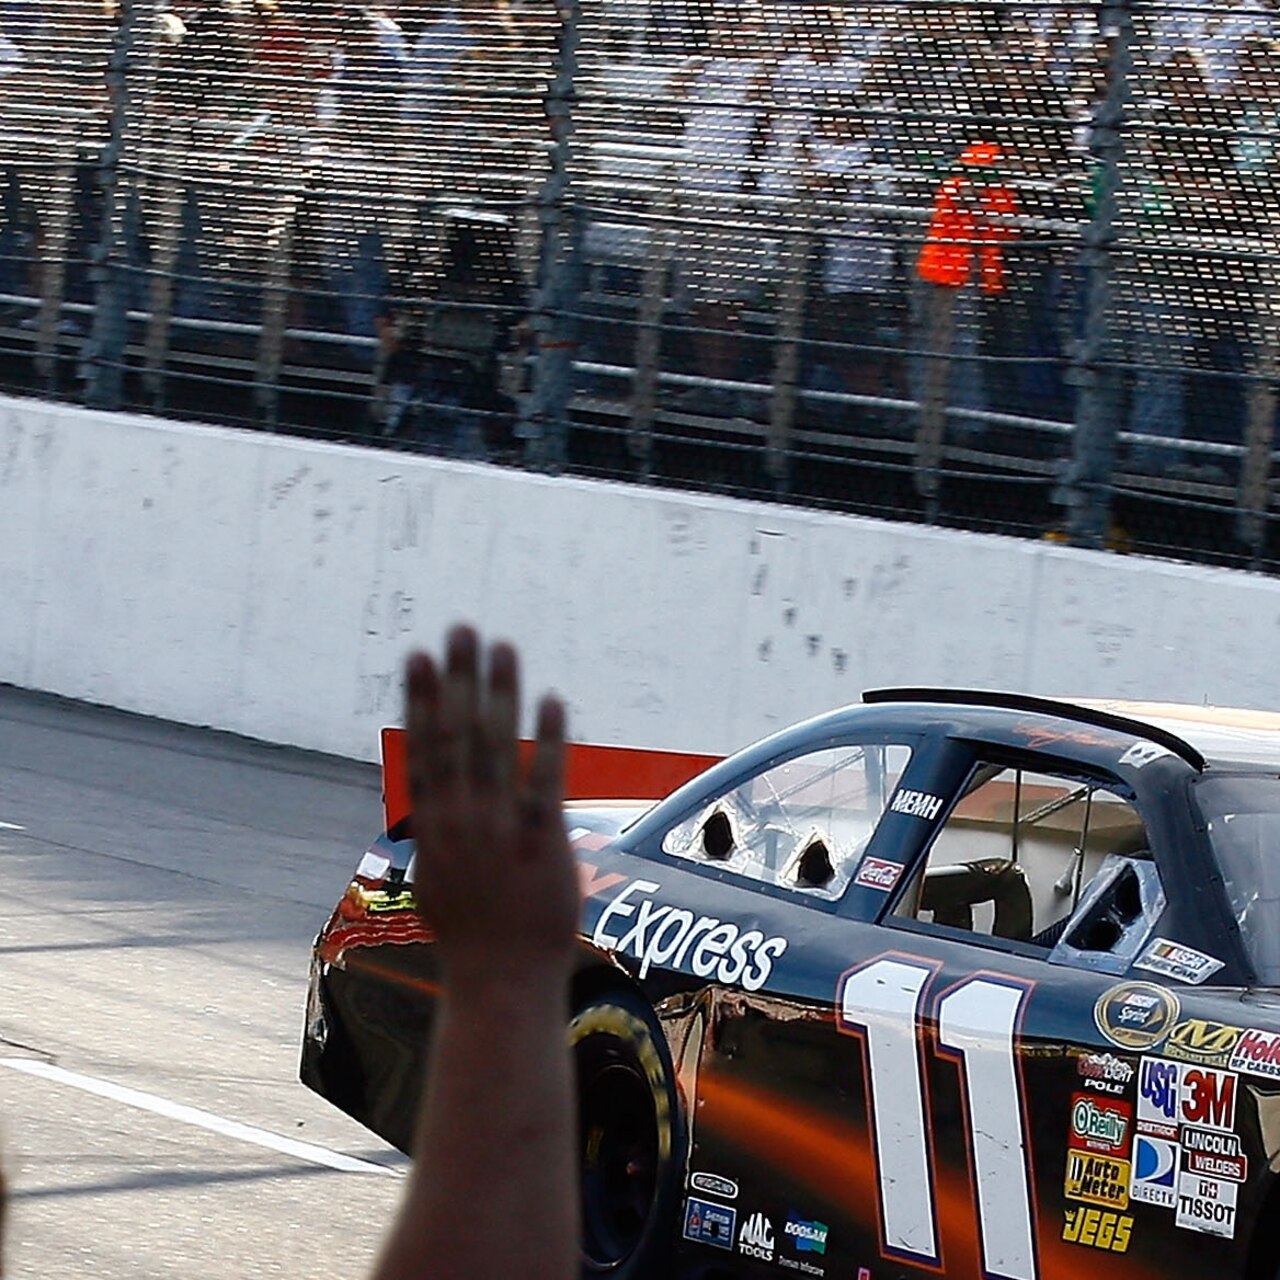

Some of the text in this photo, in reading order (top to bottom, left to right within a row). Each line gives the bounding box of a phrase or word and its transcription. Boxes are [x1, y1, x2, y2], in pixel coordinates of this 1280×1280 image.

[593, 879, 788, 991] Express
[1084, 1078, 1125, 1095] POLE
[1140, 1059, 1178, 1119] USG
[1181, 1069, 1236, 1129] 3M
[1074, 1099, 1126, 1145] O'Reilly
[1185, 1130, 1237, 1157] LINCOLN
[1085, 1157, 1120, 1181] Auto
[1195, 1154, 1241, 1177] WELDERS
[1080, 1174, 1125, 1199] Meter
[1179, 1195, 1235, 1226] TISSOT
[1063, 1207, 1134, 1252] JEGS
[738, 1243, 774, 1262] TOOLS
